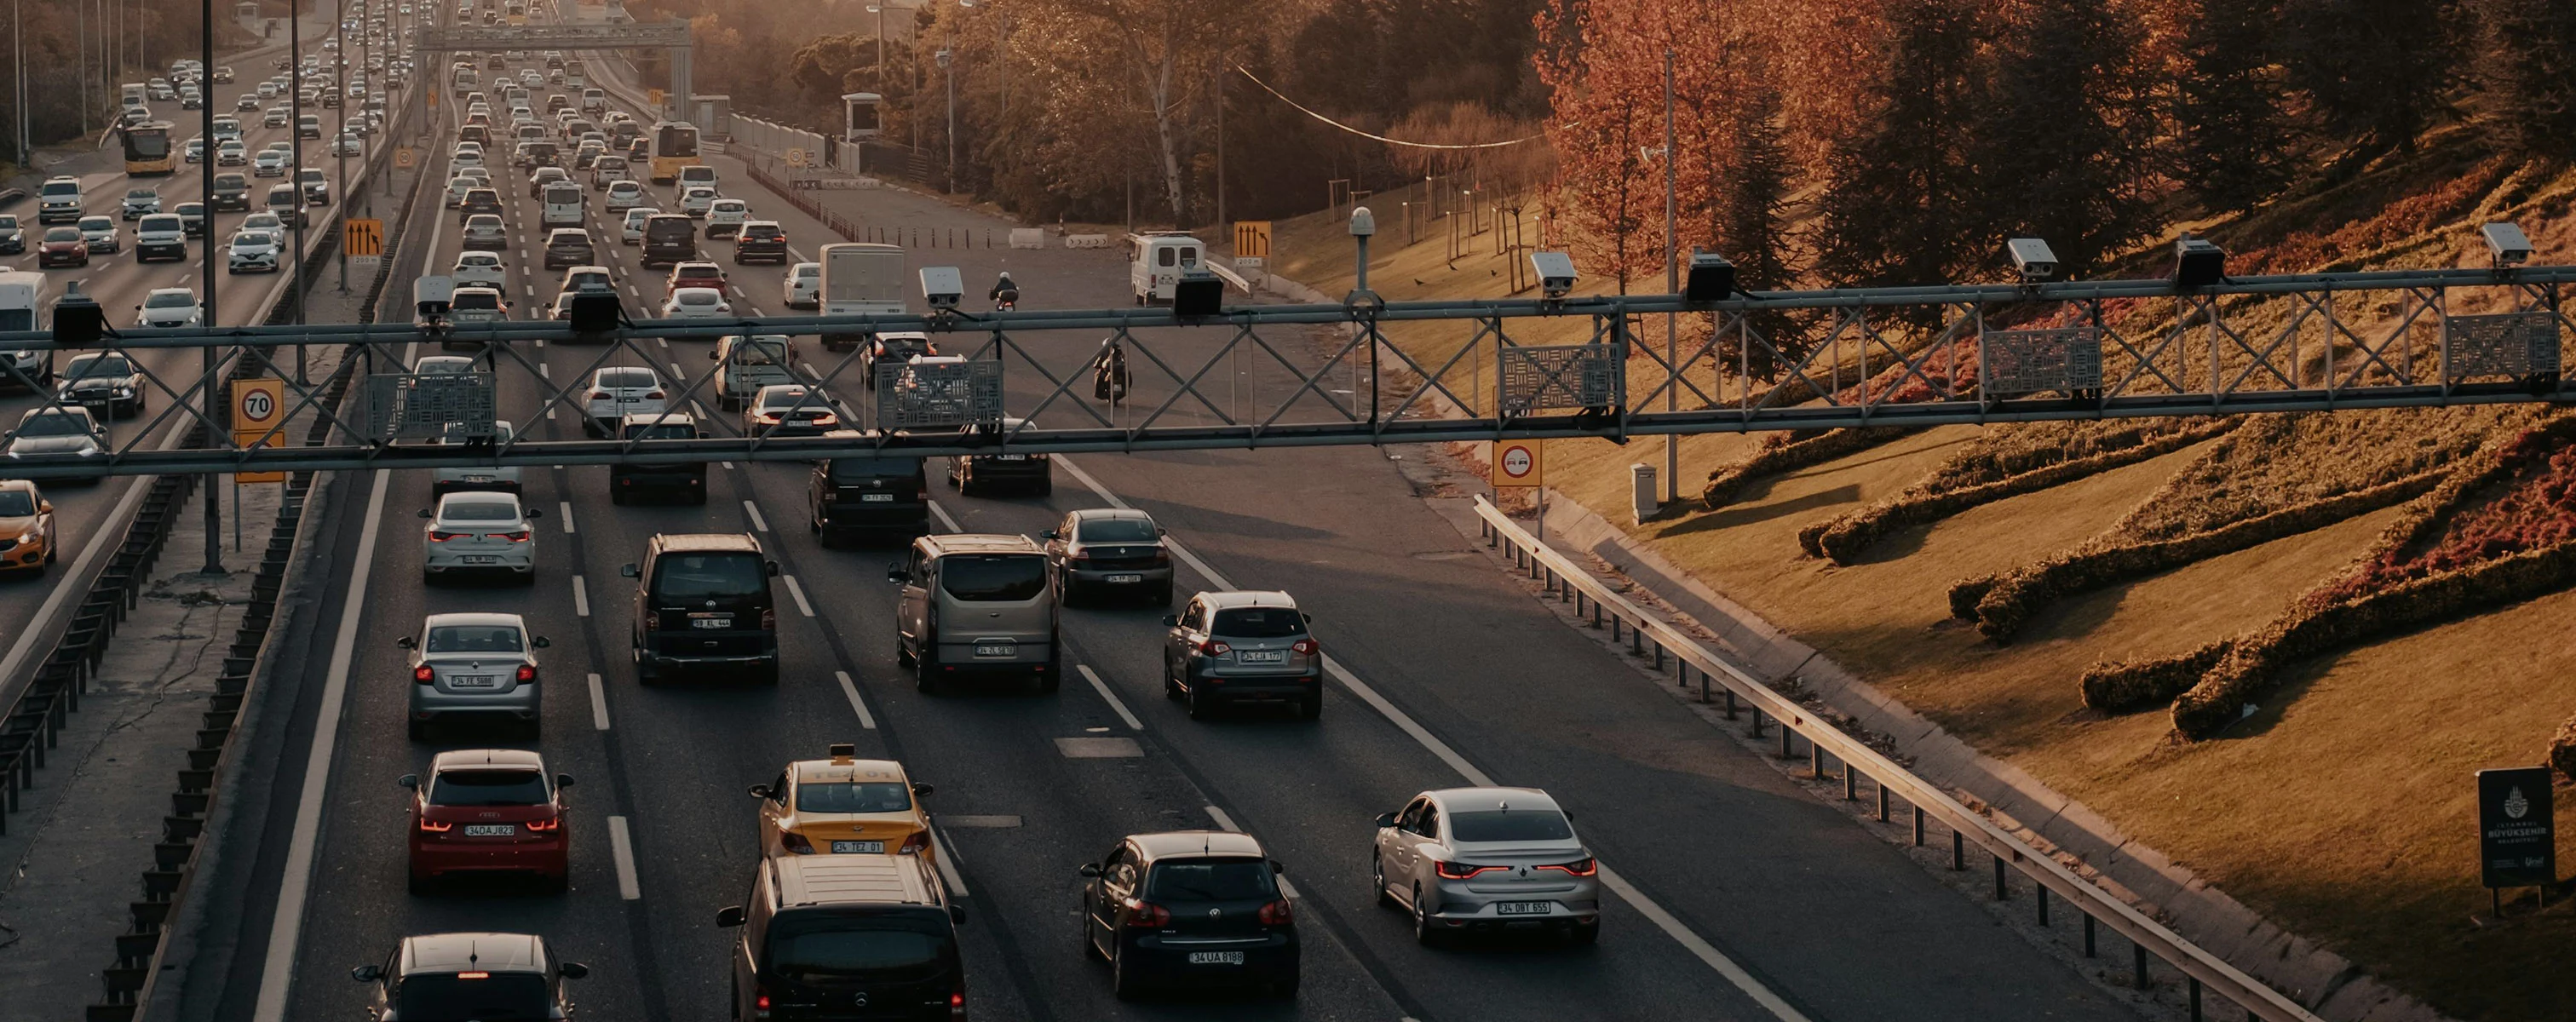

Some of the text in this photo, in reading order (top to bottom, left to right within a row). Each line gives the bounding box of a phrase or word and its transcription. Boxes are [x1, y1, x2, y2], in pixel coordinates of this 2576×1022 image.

[248, 398, 268, 413] 70
[837, 842, 880, 851] 34 TEZ 01
[1504, 904, 1512, 912] 34
[1532, 903, 1548, 912] 655
[1194, 953, 1205, 962] 34
[1206, 952, 1221, 962] UA
